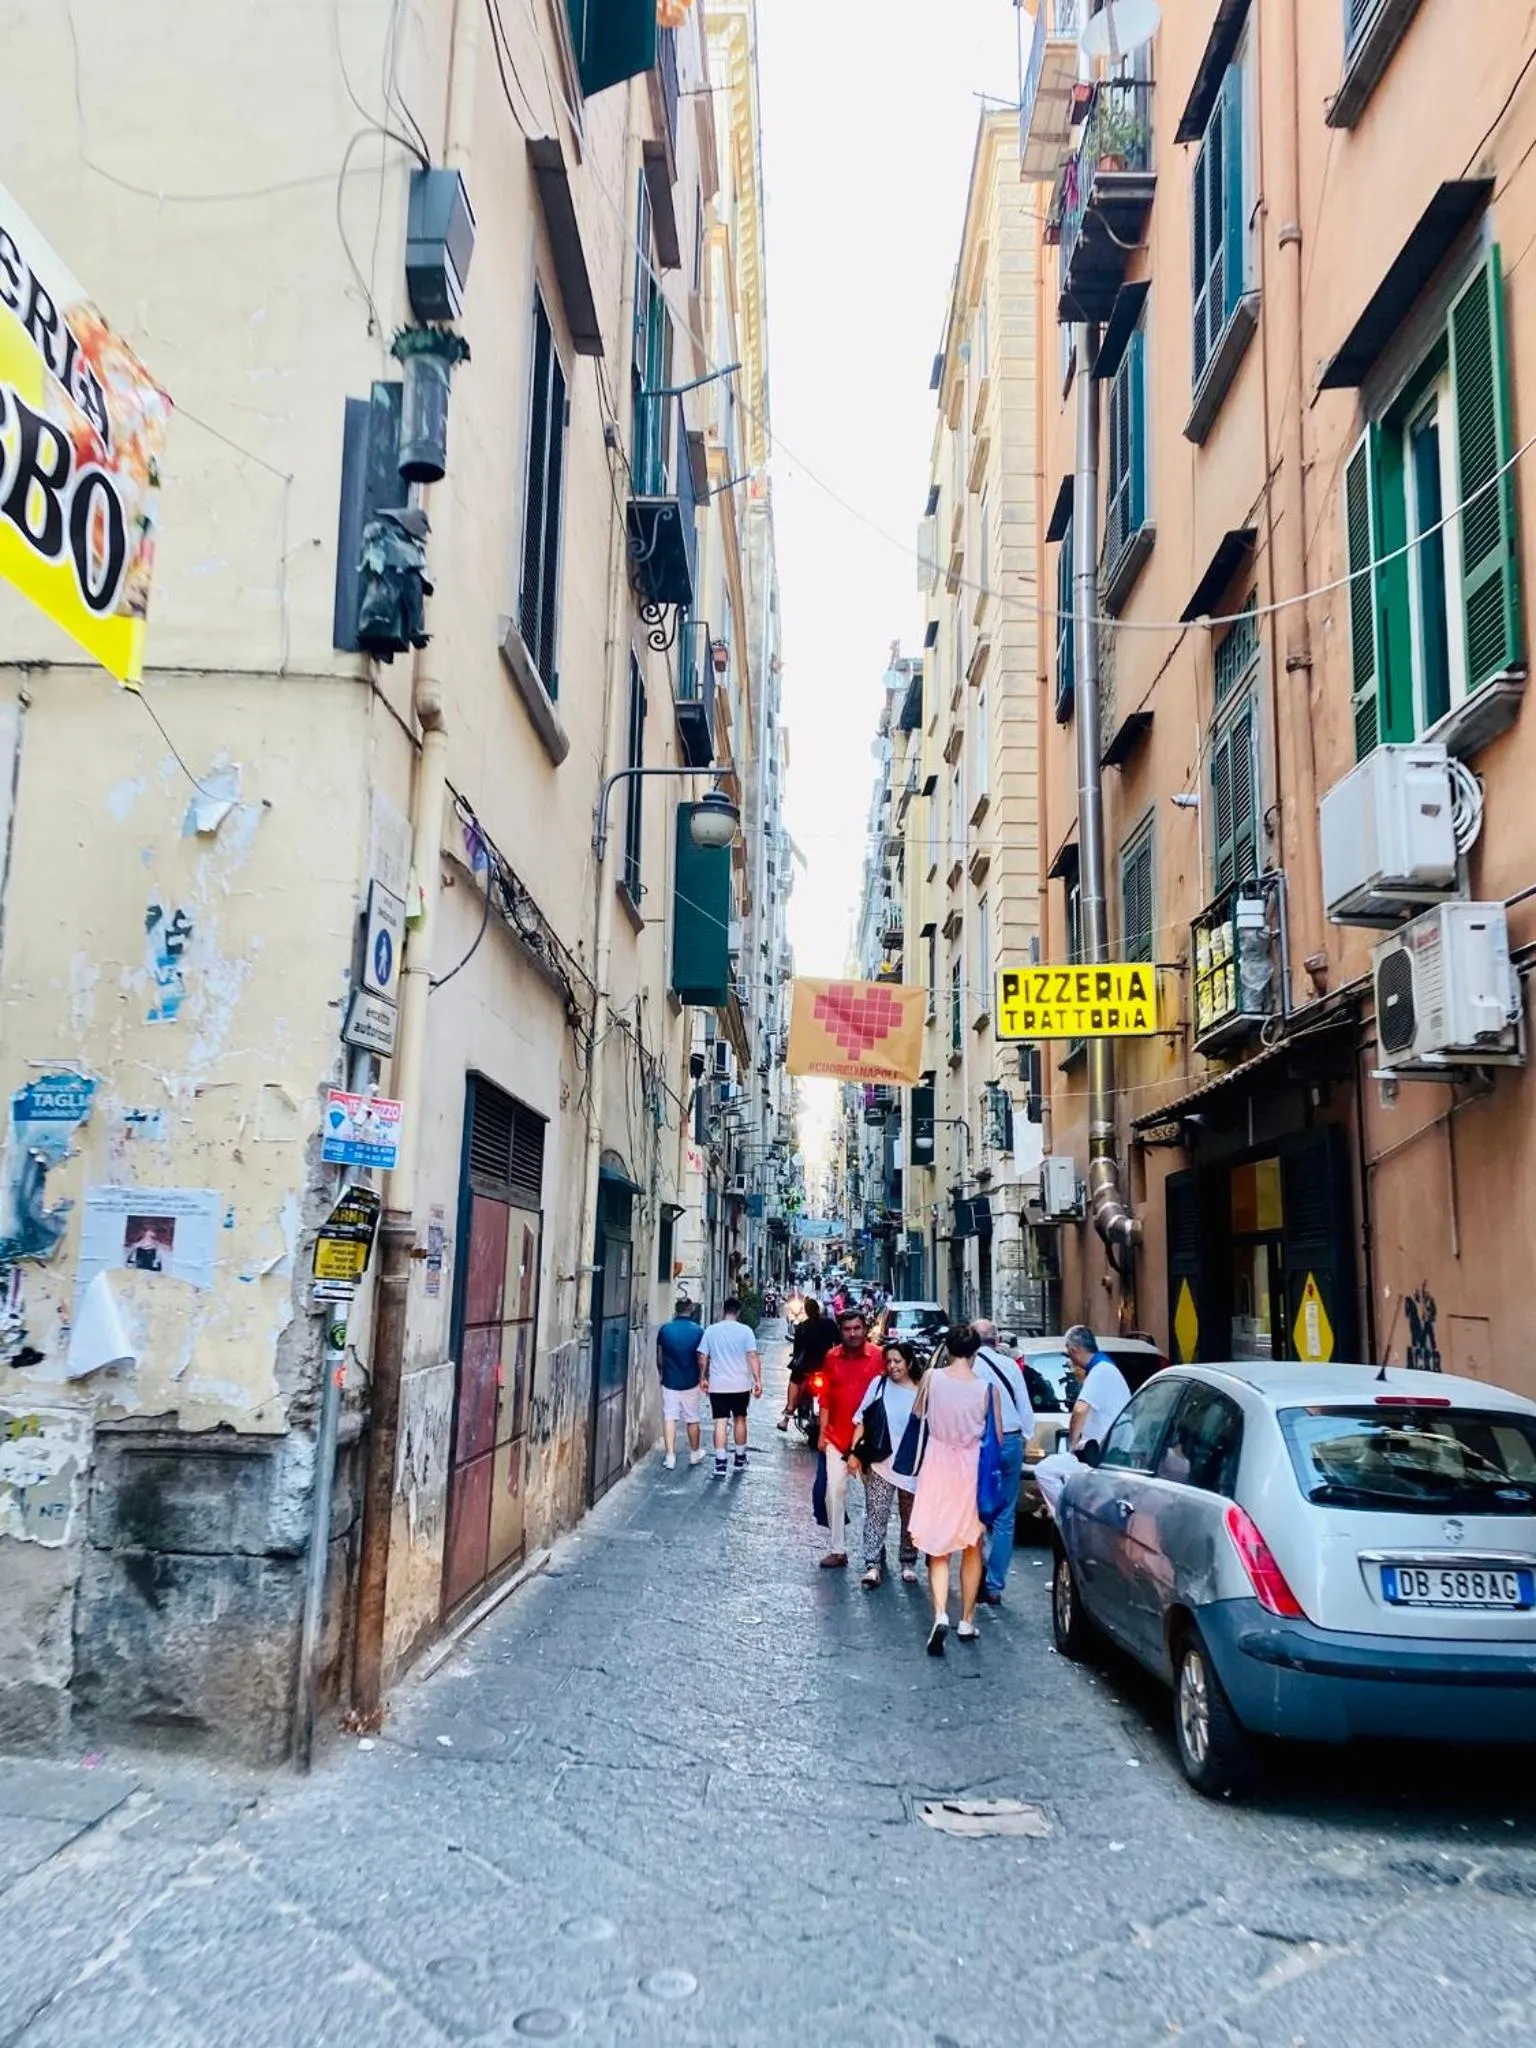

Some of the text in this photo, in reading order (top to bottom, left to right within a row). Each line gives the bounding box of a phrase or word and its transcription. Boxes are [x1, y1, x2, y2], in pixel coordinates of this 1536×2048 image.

[0, 388, 125, 611] BO
[1003, 971, 1147, 1004] PIZZERIA
[1004, 1008, 1147, 1031] TRATTORIA
[32, 1093, 90, 1108] TAGLI
[1399, 1570, 1430, 1597] DB
[1441, 1572, 1517, 1600] 588AG
